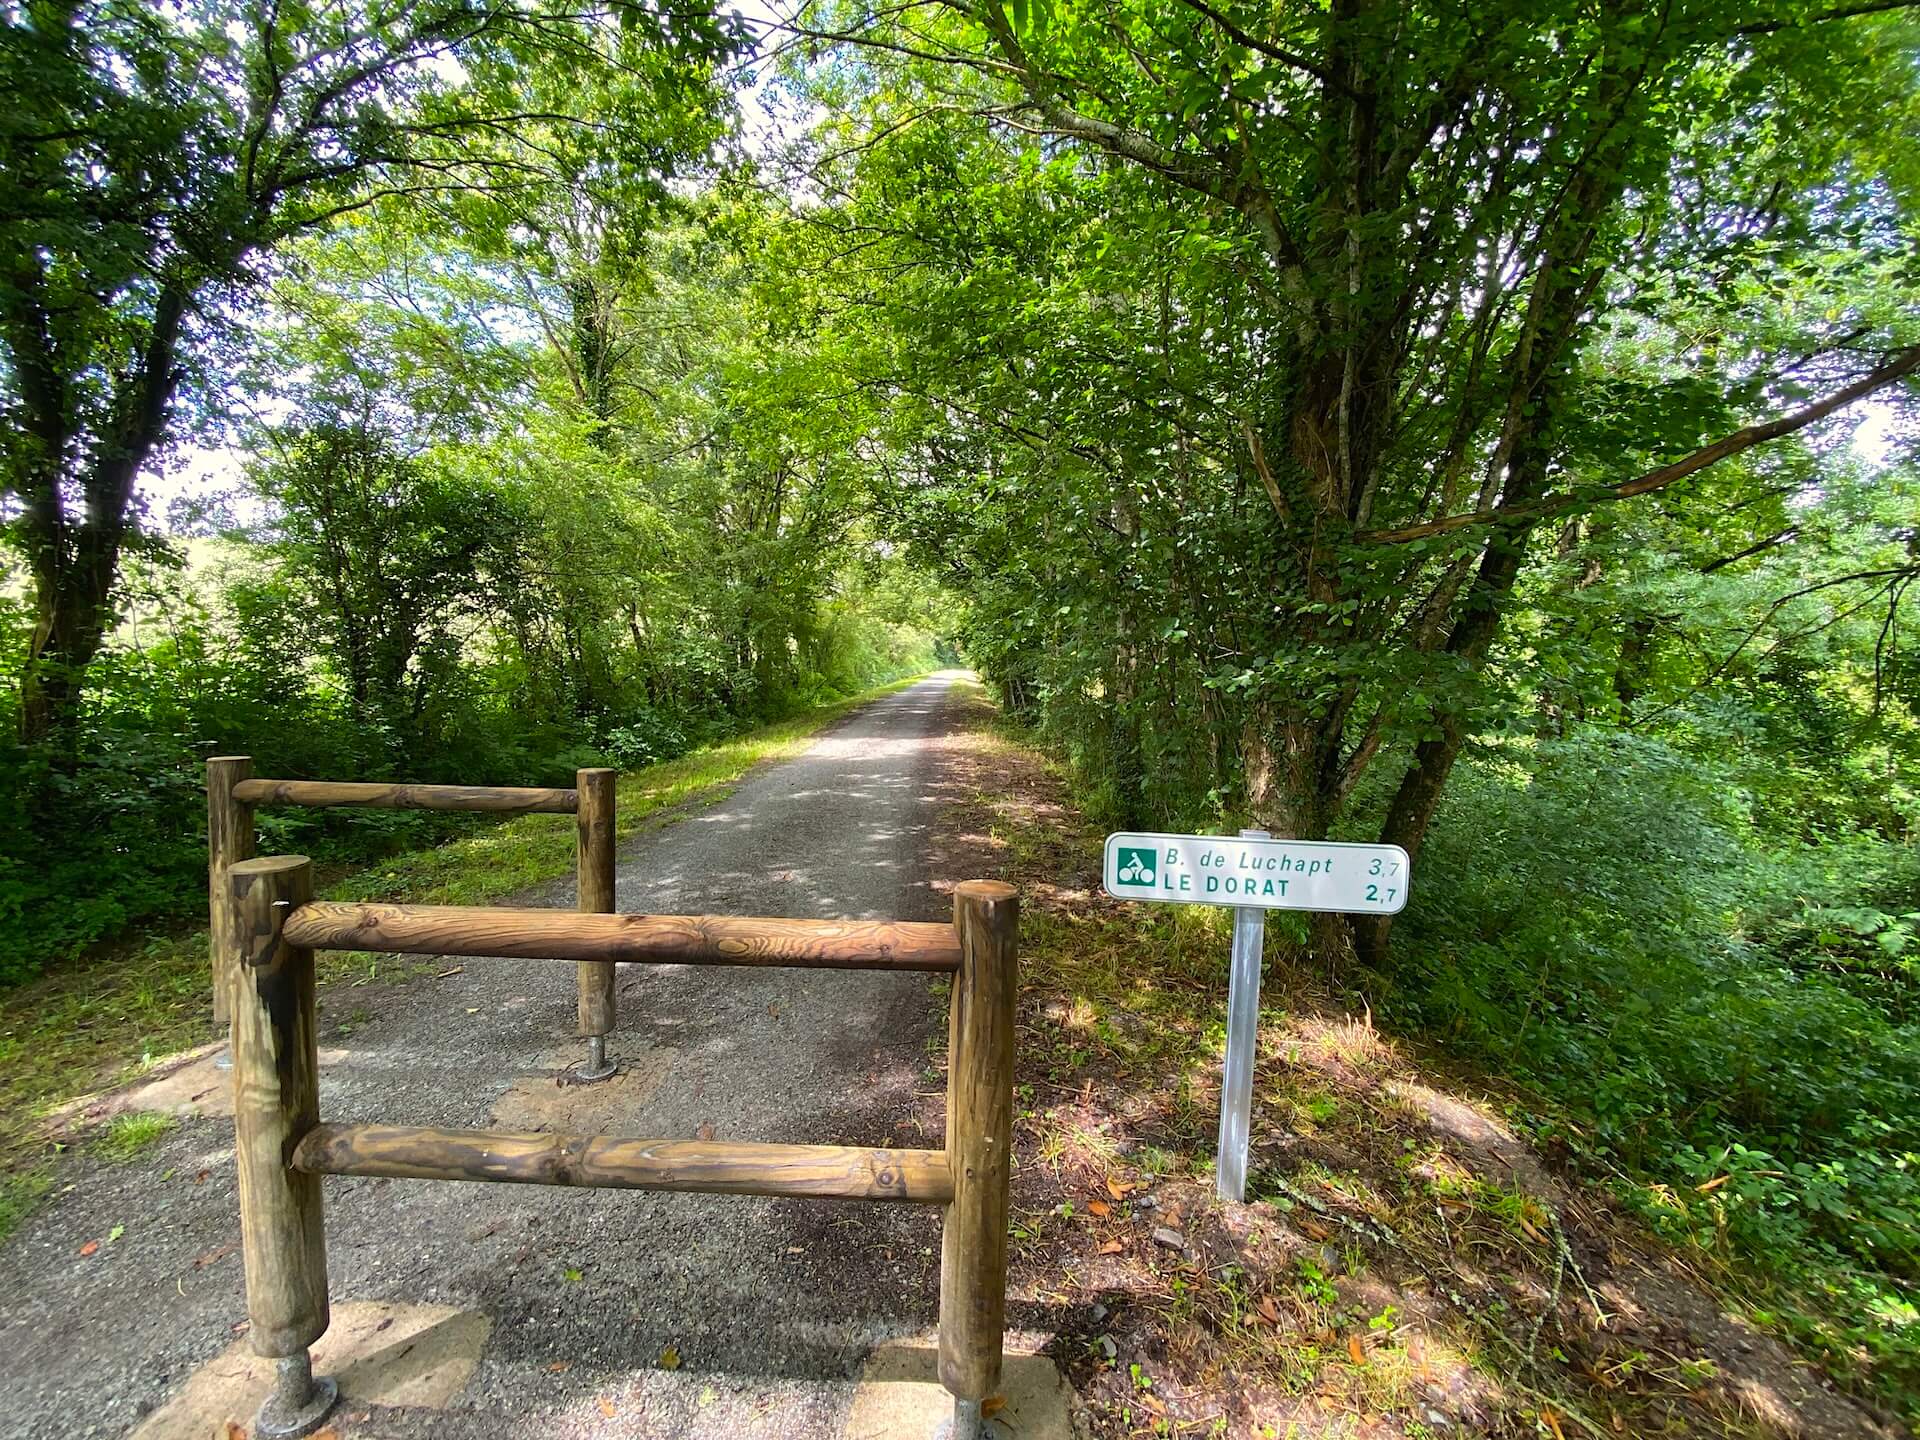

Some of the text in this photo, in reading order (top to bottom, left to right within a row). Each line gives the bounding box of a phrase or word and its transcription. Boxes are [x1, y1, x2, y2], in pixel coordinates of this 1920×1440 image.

[1165, 848, 1400, 877] B. de Luchapt 3,7
[1164, 873, 1397, 904] LE DORAT 2,7
